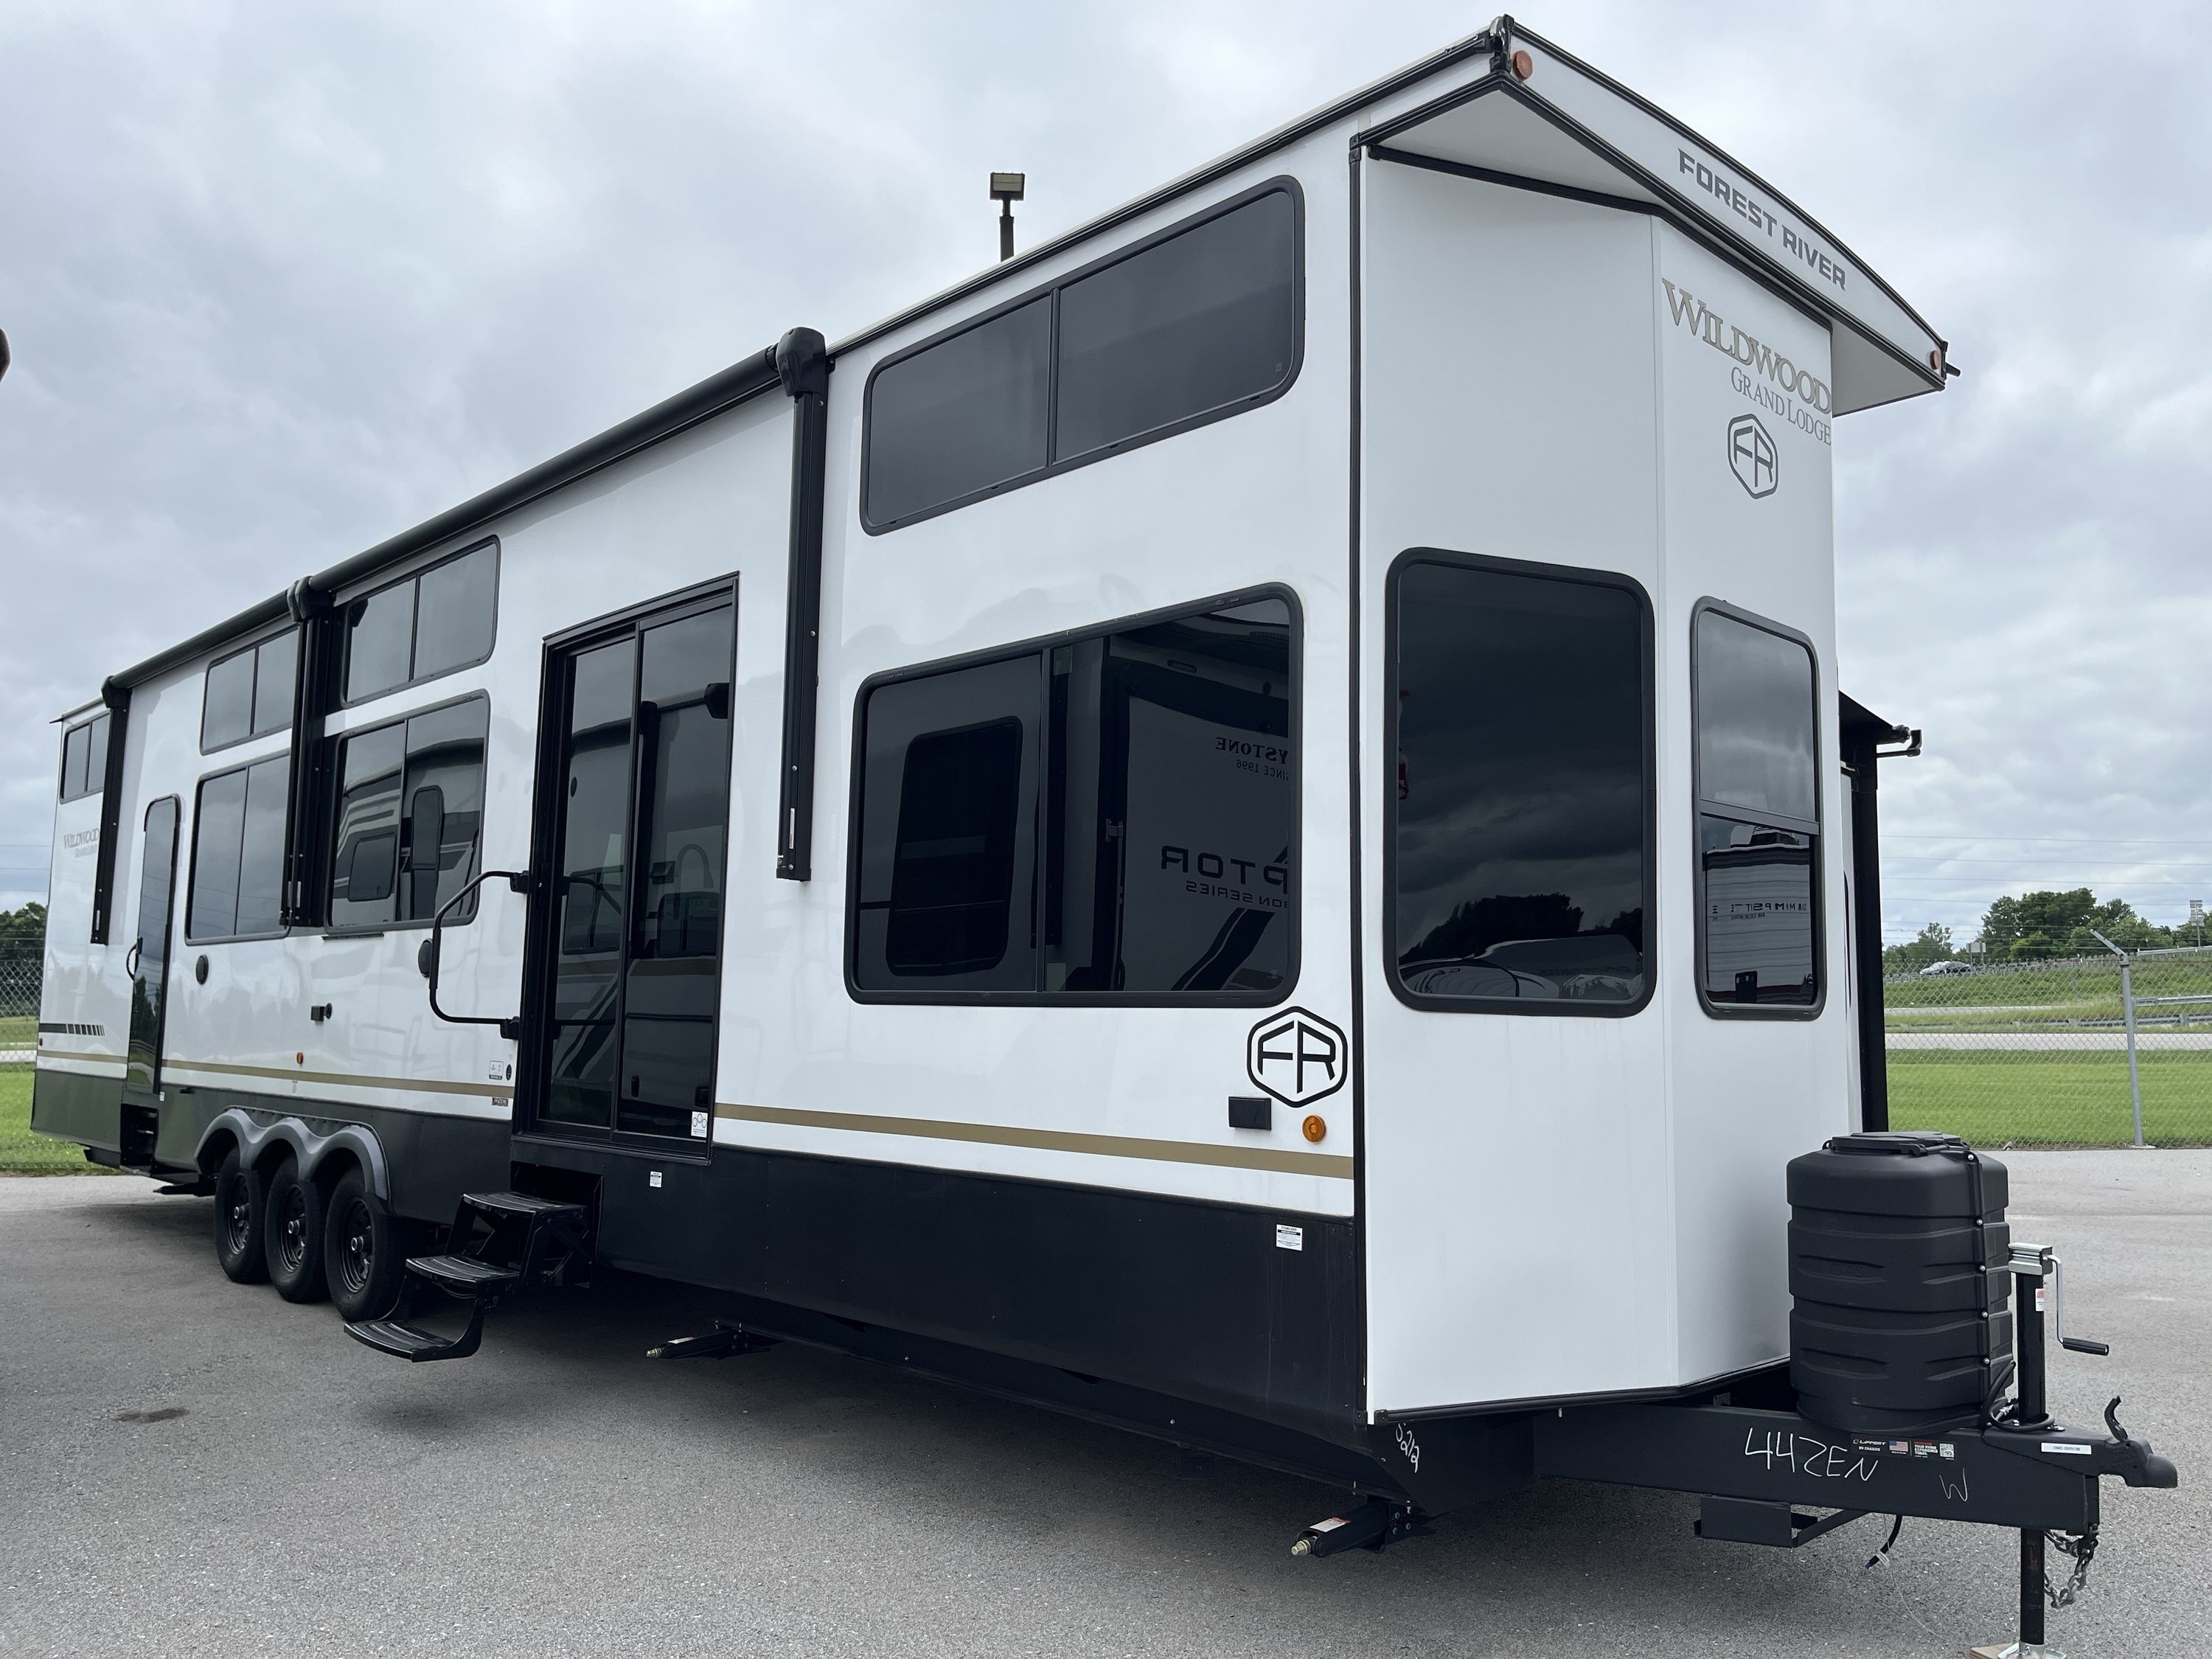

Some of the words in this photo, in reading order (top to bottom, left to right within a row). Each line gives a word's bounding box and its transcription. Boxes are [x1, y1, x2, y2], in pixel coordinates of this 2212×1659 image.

[1678, 147, 1777, 237] FOREST
[1781, 224, 1846, 291] RIVER
[1662, 278, 1832, 414] WILDWOOD
[1731, 366, 1785, 416] GRAND
[1787, 398, 1832, 446] LODGE
[1733, 425, 1773, 487] FR
[1257, 1020, 1336, 1094] FR
